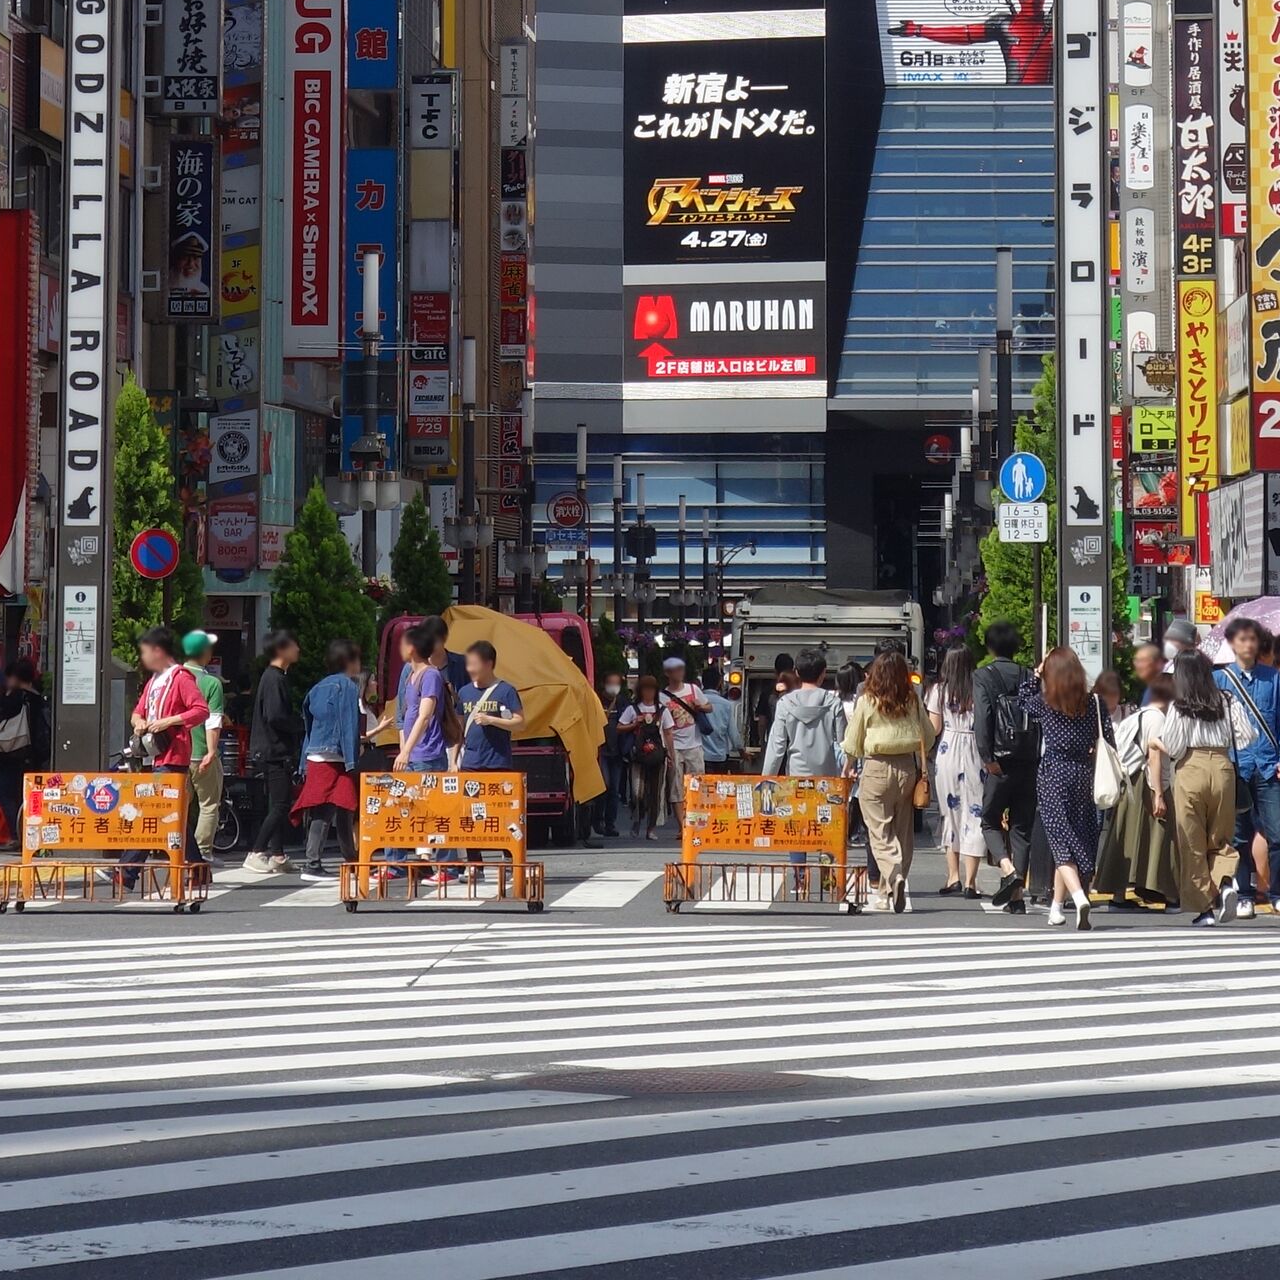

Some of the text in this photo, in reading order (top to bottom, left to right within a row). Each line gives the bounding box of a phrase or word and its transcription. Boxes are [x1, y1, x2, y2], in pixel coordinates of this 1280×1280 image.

[632, 108, 816, 140] これがトドメだ。
[1178, 114, 1214, 220] 甘太郎
[176, 149, 203, 228] 海の家
[302, 79, 321, 317] BIC CAMERA SHIDAX
[1066, 31, 1097, 436] ゴジラロード
[1183, 235, 1212, 253] 4F
[1183, 256, 1212, 273] 3F
[690, 299, 814, 332] MARUHAN
[67, 329, 100, 472] ROAD
[417, 423, 442, 433] 729
[385, 816, 499, 833] 歩行者専用
